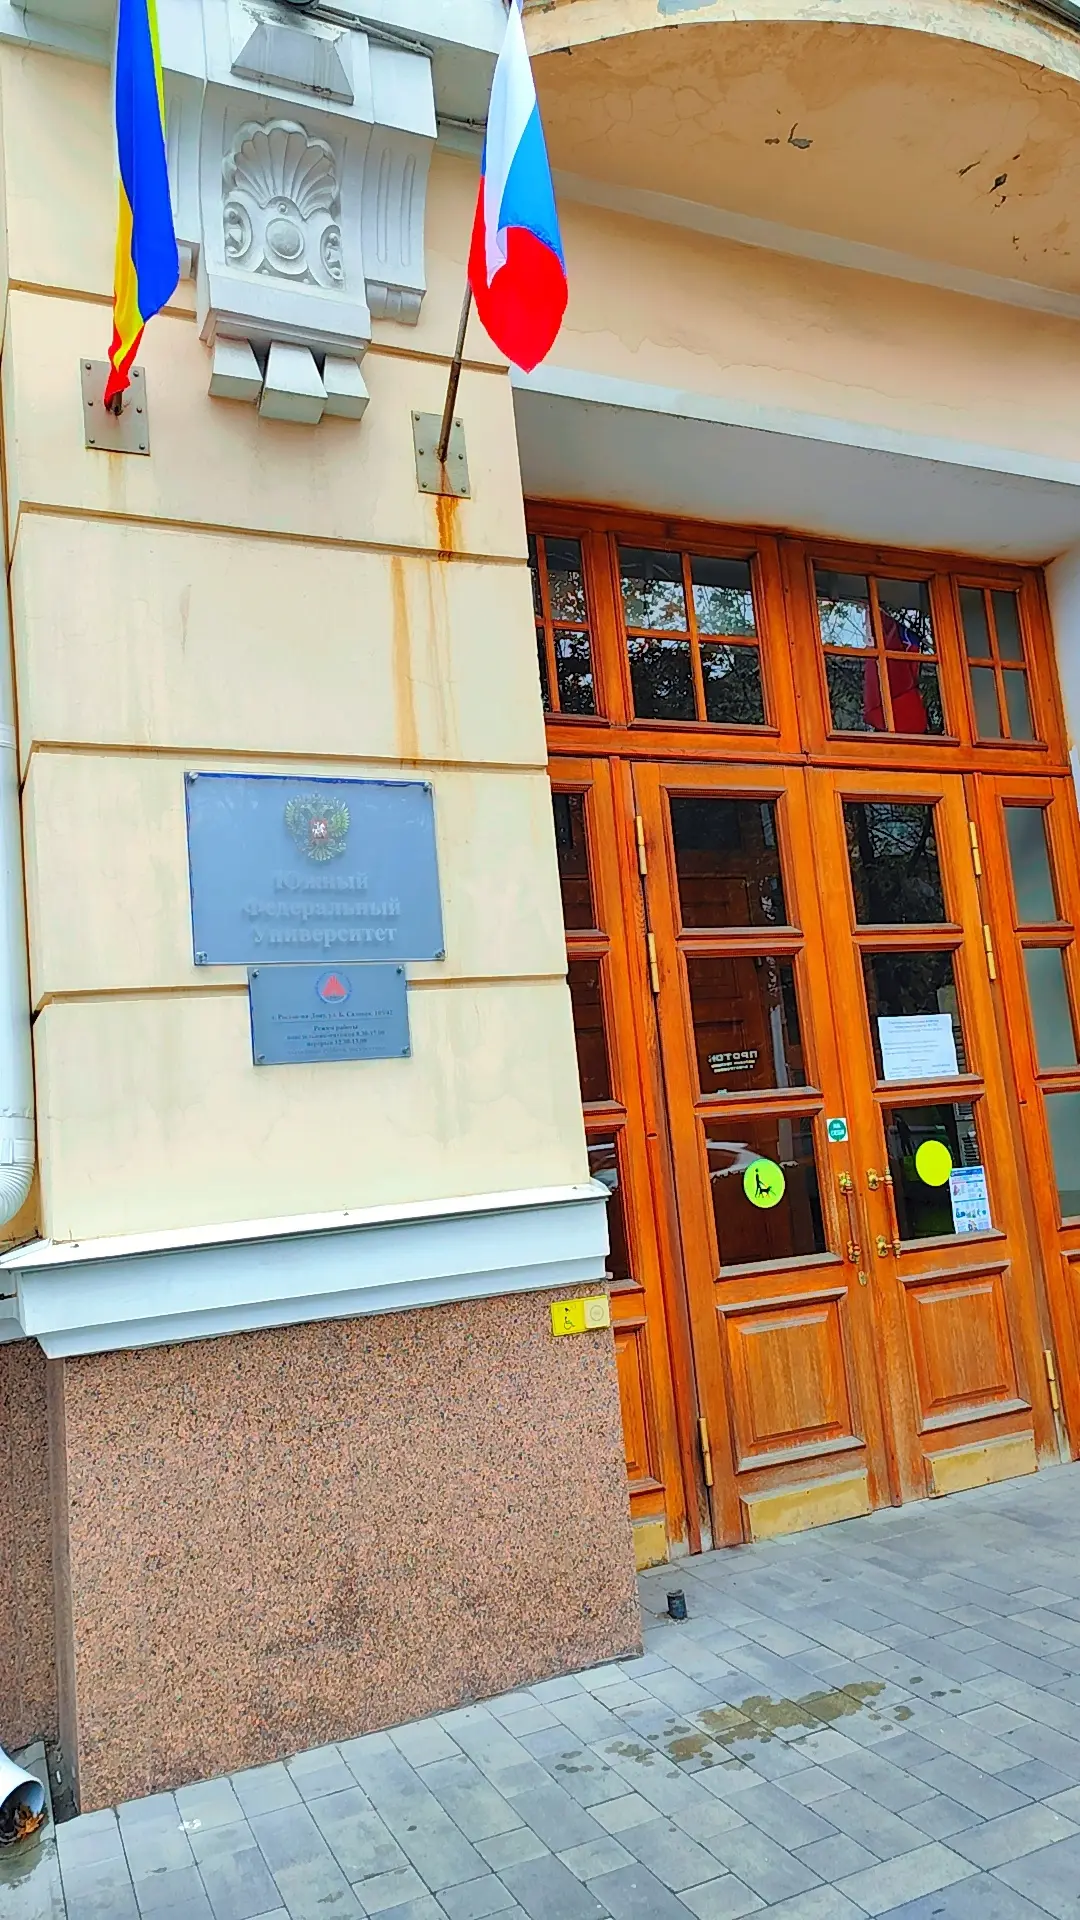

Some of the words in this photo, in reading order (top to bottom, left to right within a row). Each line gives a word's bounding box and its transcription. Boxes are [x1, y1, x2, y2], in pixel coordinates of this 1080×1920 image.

[274, 871, 369, 891] Южный
[245, 897, 401, 920] Федеральный
[253, 924, 398, 948] Университет
